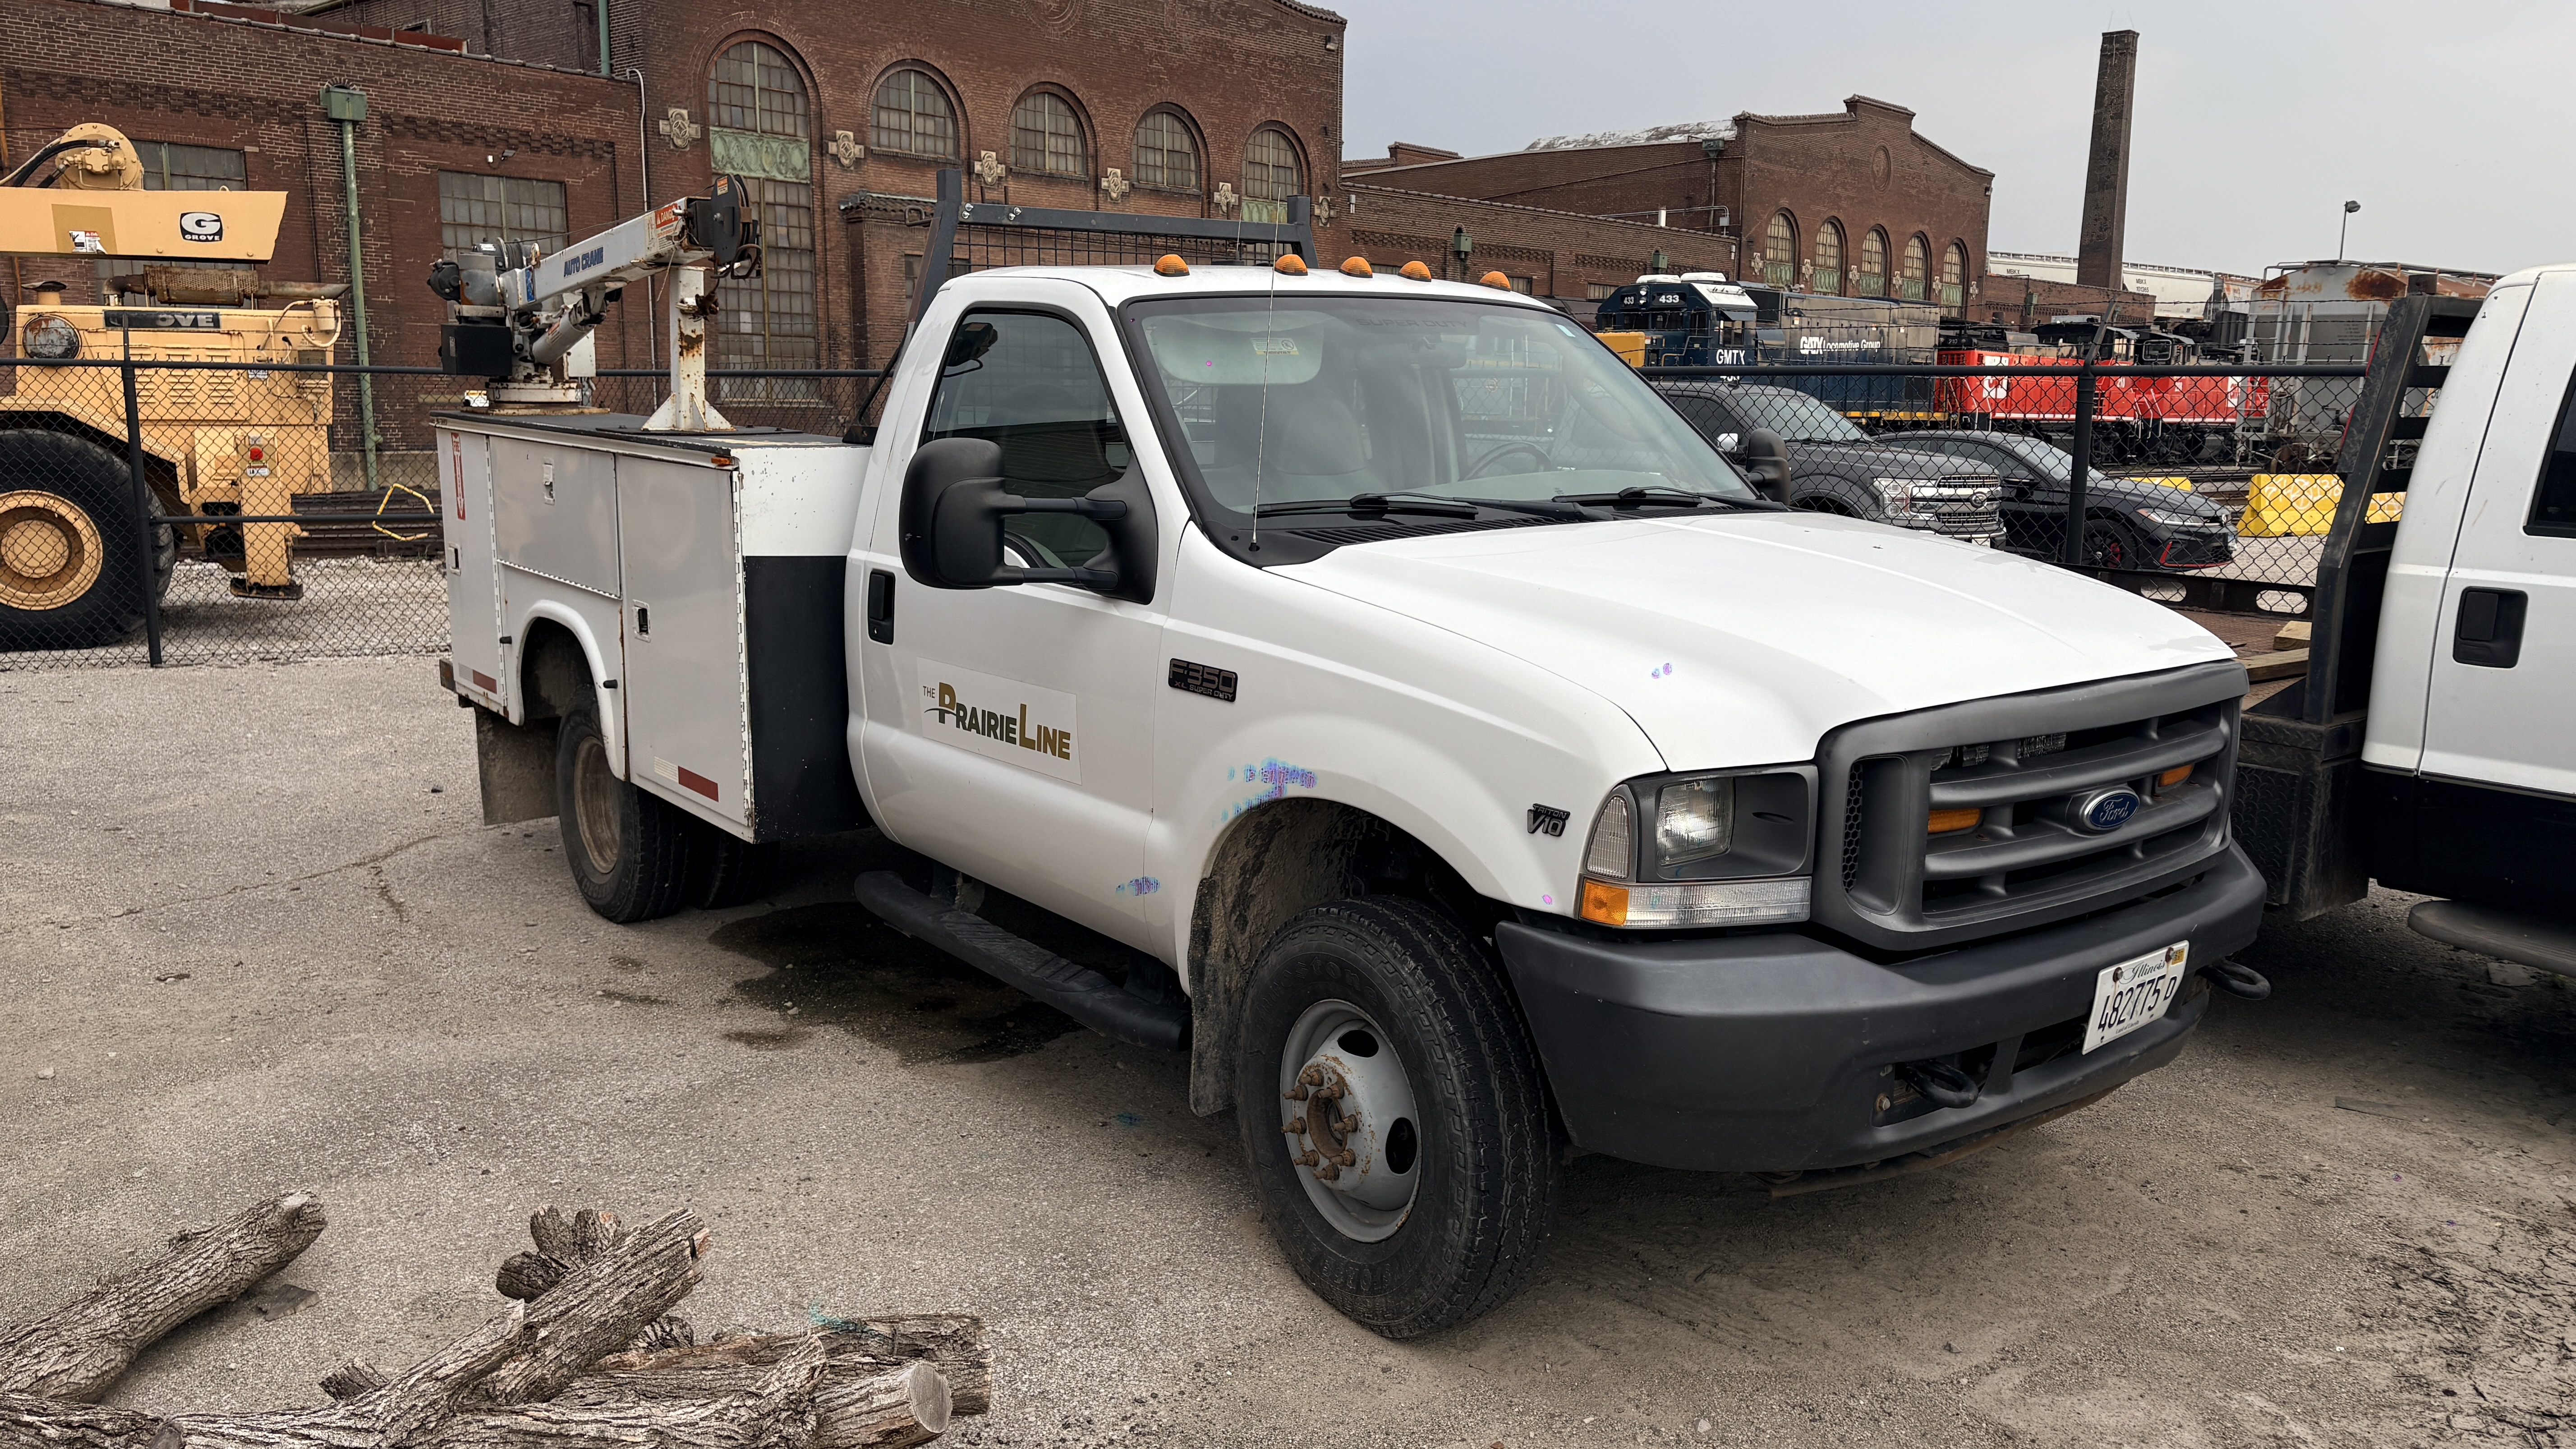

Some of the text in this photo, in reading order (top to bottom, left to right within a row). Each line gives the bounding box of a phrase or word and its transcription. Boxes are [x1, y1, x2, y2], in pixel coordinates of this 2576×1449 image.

[181, 213, 221, 234] G
[564, 247, 603, 277] AUTO CRANE
[1624, 296, 1634, 304] 433
[1659, 294, 1679, 303] 433
[1823, 340, 1859, 352] Locomotive
[1861, 339, 1881, 353] Group
[1716, 349, 1745, 365] GMTX
[923, 685, 935, 698] THE
[1174, 681, 1233, 700] XL SUPER DUTY
[1533, 805, 1567, 819] TRITON
[2099, 798, 2130, 823] Ford
[1527, 810, 1563, 836] V10
[2120, 960, 2165, 984] Illinois
[2098, 974, 2177, 1032] 482775 D
